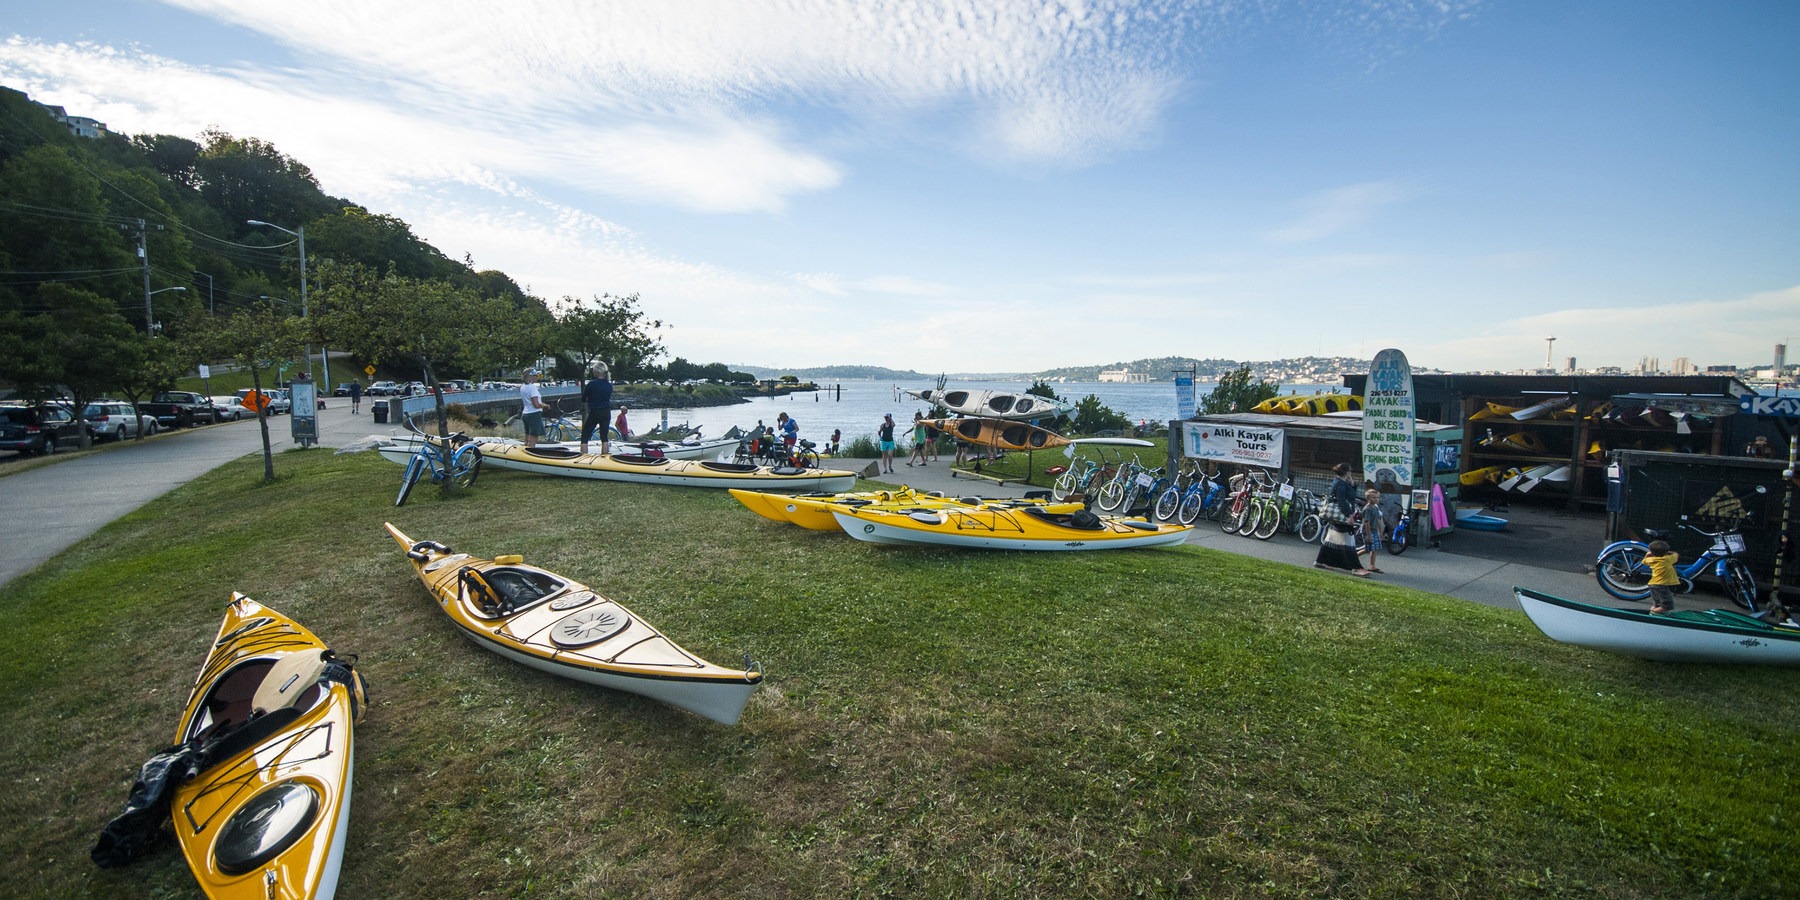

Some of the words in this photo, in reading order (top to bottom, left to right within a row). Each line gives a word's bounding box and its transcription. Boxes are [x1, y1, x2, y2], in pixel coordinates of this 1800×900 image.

[1372, 370, 1404, 381] KAYAK
[1374, 380, 1402, 391] TOURS
[1369, 397, 1399, 406] KAYAK
[1365, 408, 1387, 417] PADDLE
[1389, 409, 1407, 418] BOARD
[1374, 420, 1398, 430] BIKES
[1214, 428, 1235, 438] Alki
[1238, 429, 1274, 442] Kayak
[1364, 432, 1385, 441] LONG
[1386, 432, 1407, 442] BOARD
[1236, 440, 1267, 451] Tours
[1366, 443, 1400, 454] SKATES
[1231, 448, 1273, 459] 206-953-0237
[1363, 454, 1387, 464] FISHING
[1388, 455, 1404, 465] BOAT
